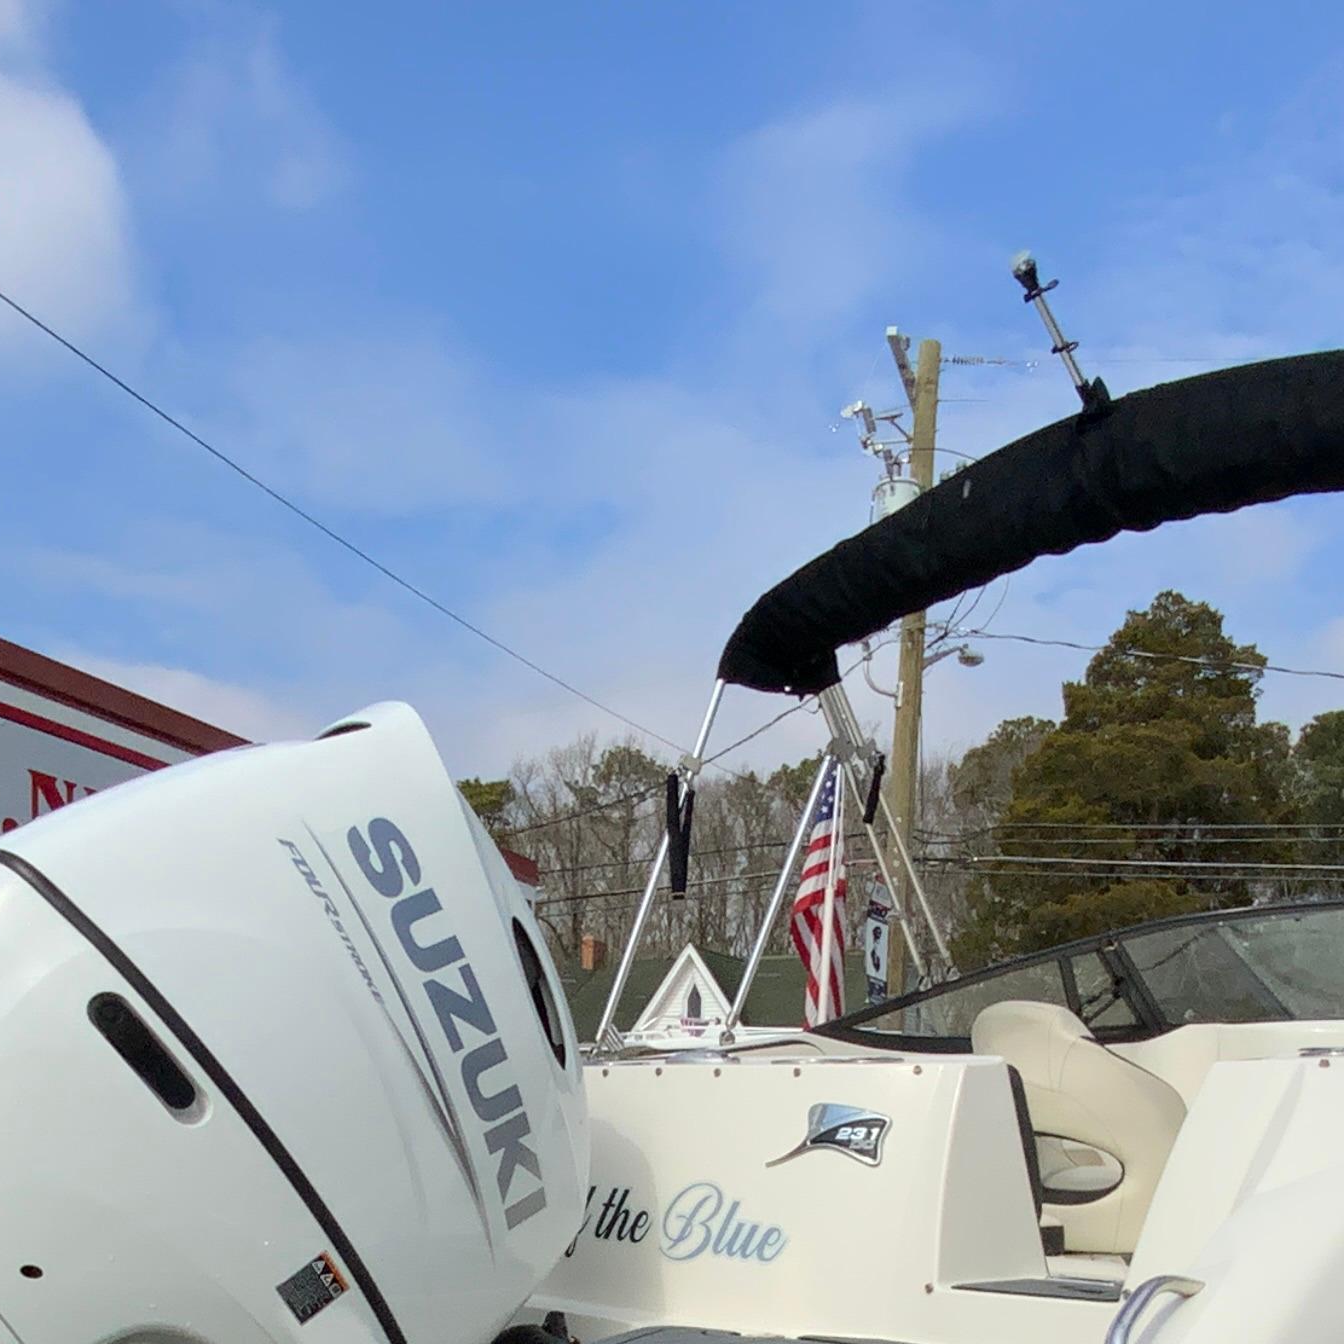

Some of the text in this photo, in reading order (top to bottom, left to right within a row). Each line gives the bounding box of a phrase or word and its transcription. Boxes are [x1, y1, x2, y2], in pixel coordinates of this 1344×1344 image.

[347, 817, 548, 1231] SUZUKI
[835, 1127, 881, 1141] 231
[594, 1187, 653, 1244] the
[659, 1182, 788, 1263] Blue
